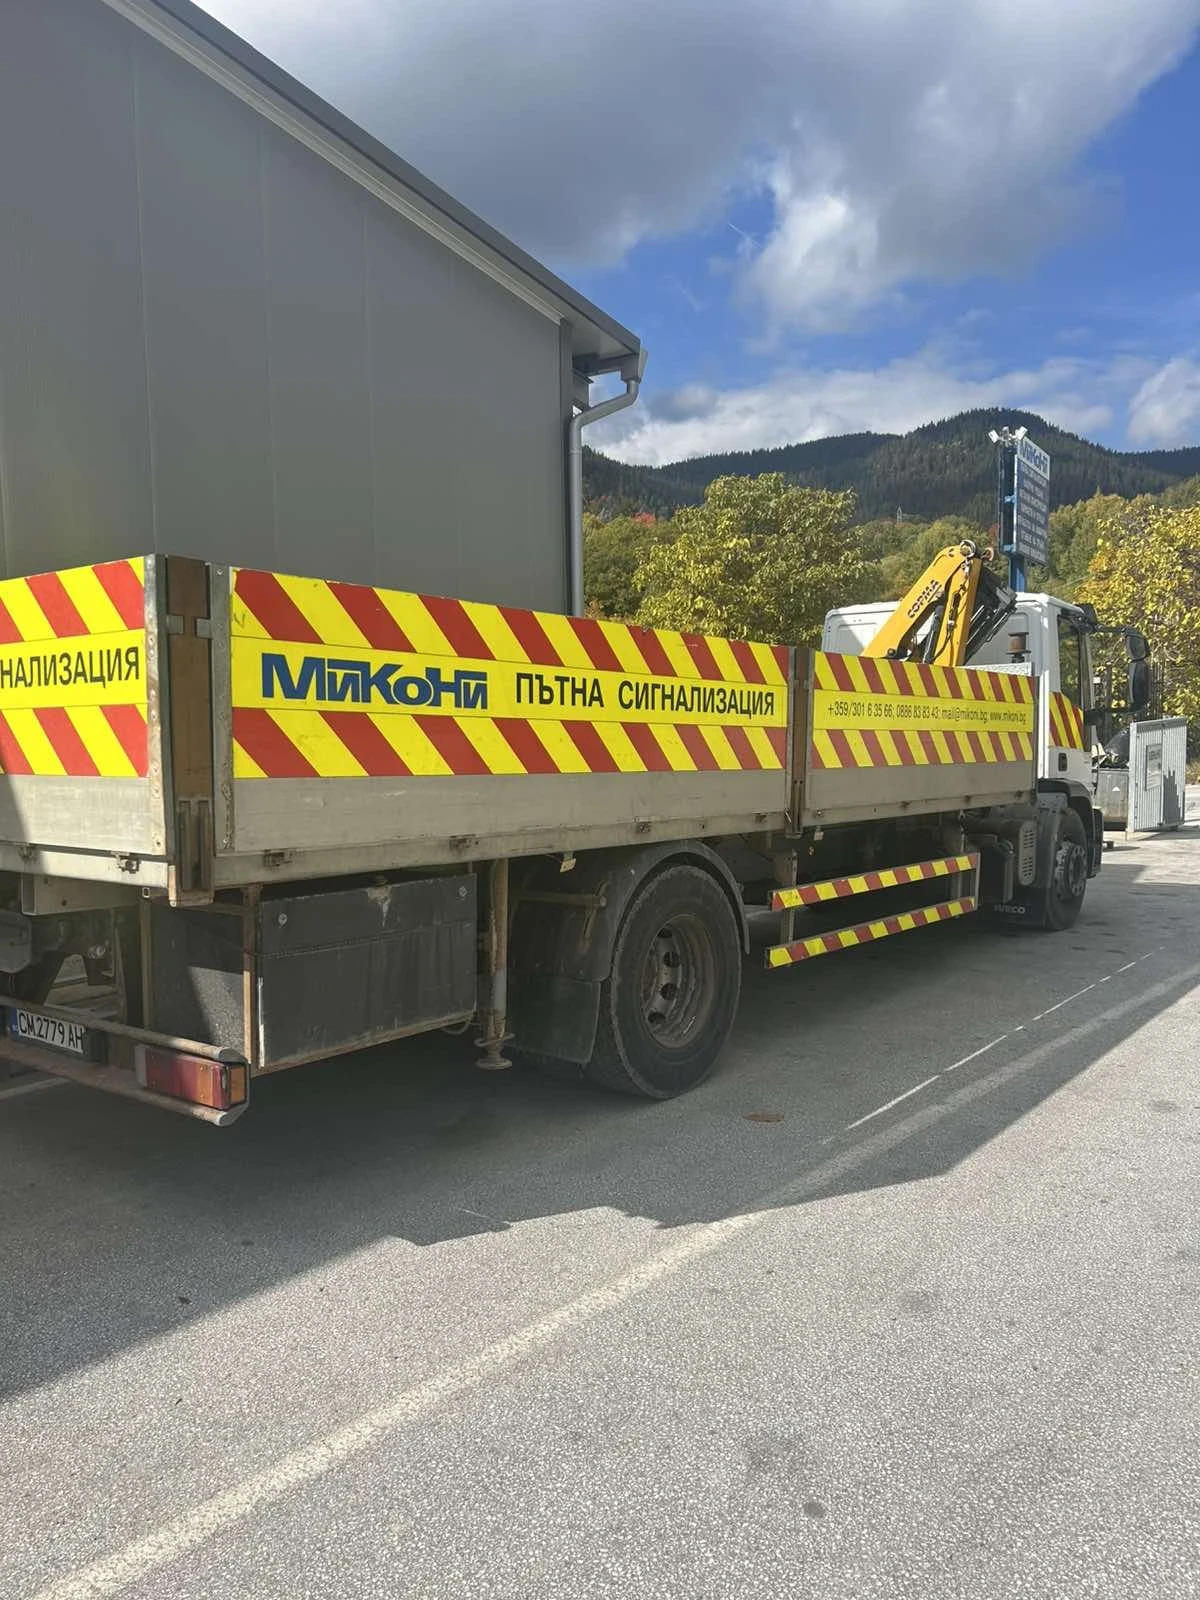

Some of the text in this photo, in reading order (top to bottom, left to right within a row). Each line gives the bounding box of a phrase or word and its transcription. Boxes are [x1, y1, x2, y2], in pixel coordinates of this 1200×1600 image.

[0, 646, 139, 689] НАЛИЗАЦИЯ
[515, 672, 604, 708] ПЪТНА
[618, 679, 775, 720] СИГНАЛИЗАЦИЯ
[828, 701, 865, 718] +359/301
[867, 702, 873, 718] 6
[873, 703, 883, 718] 35
